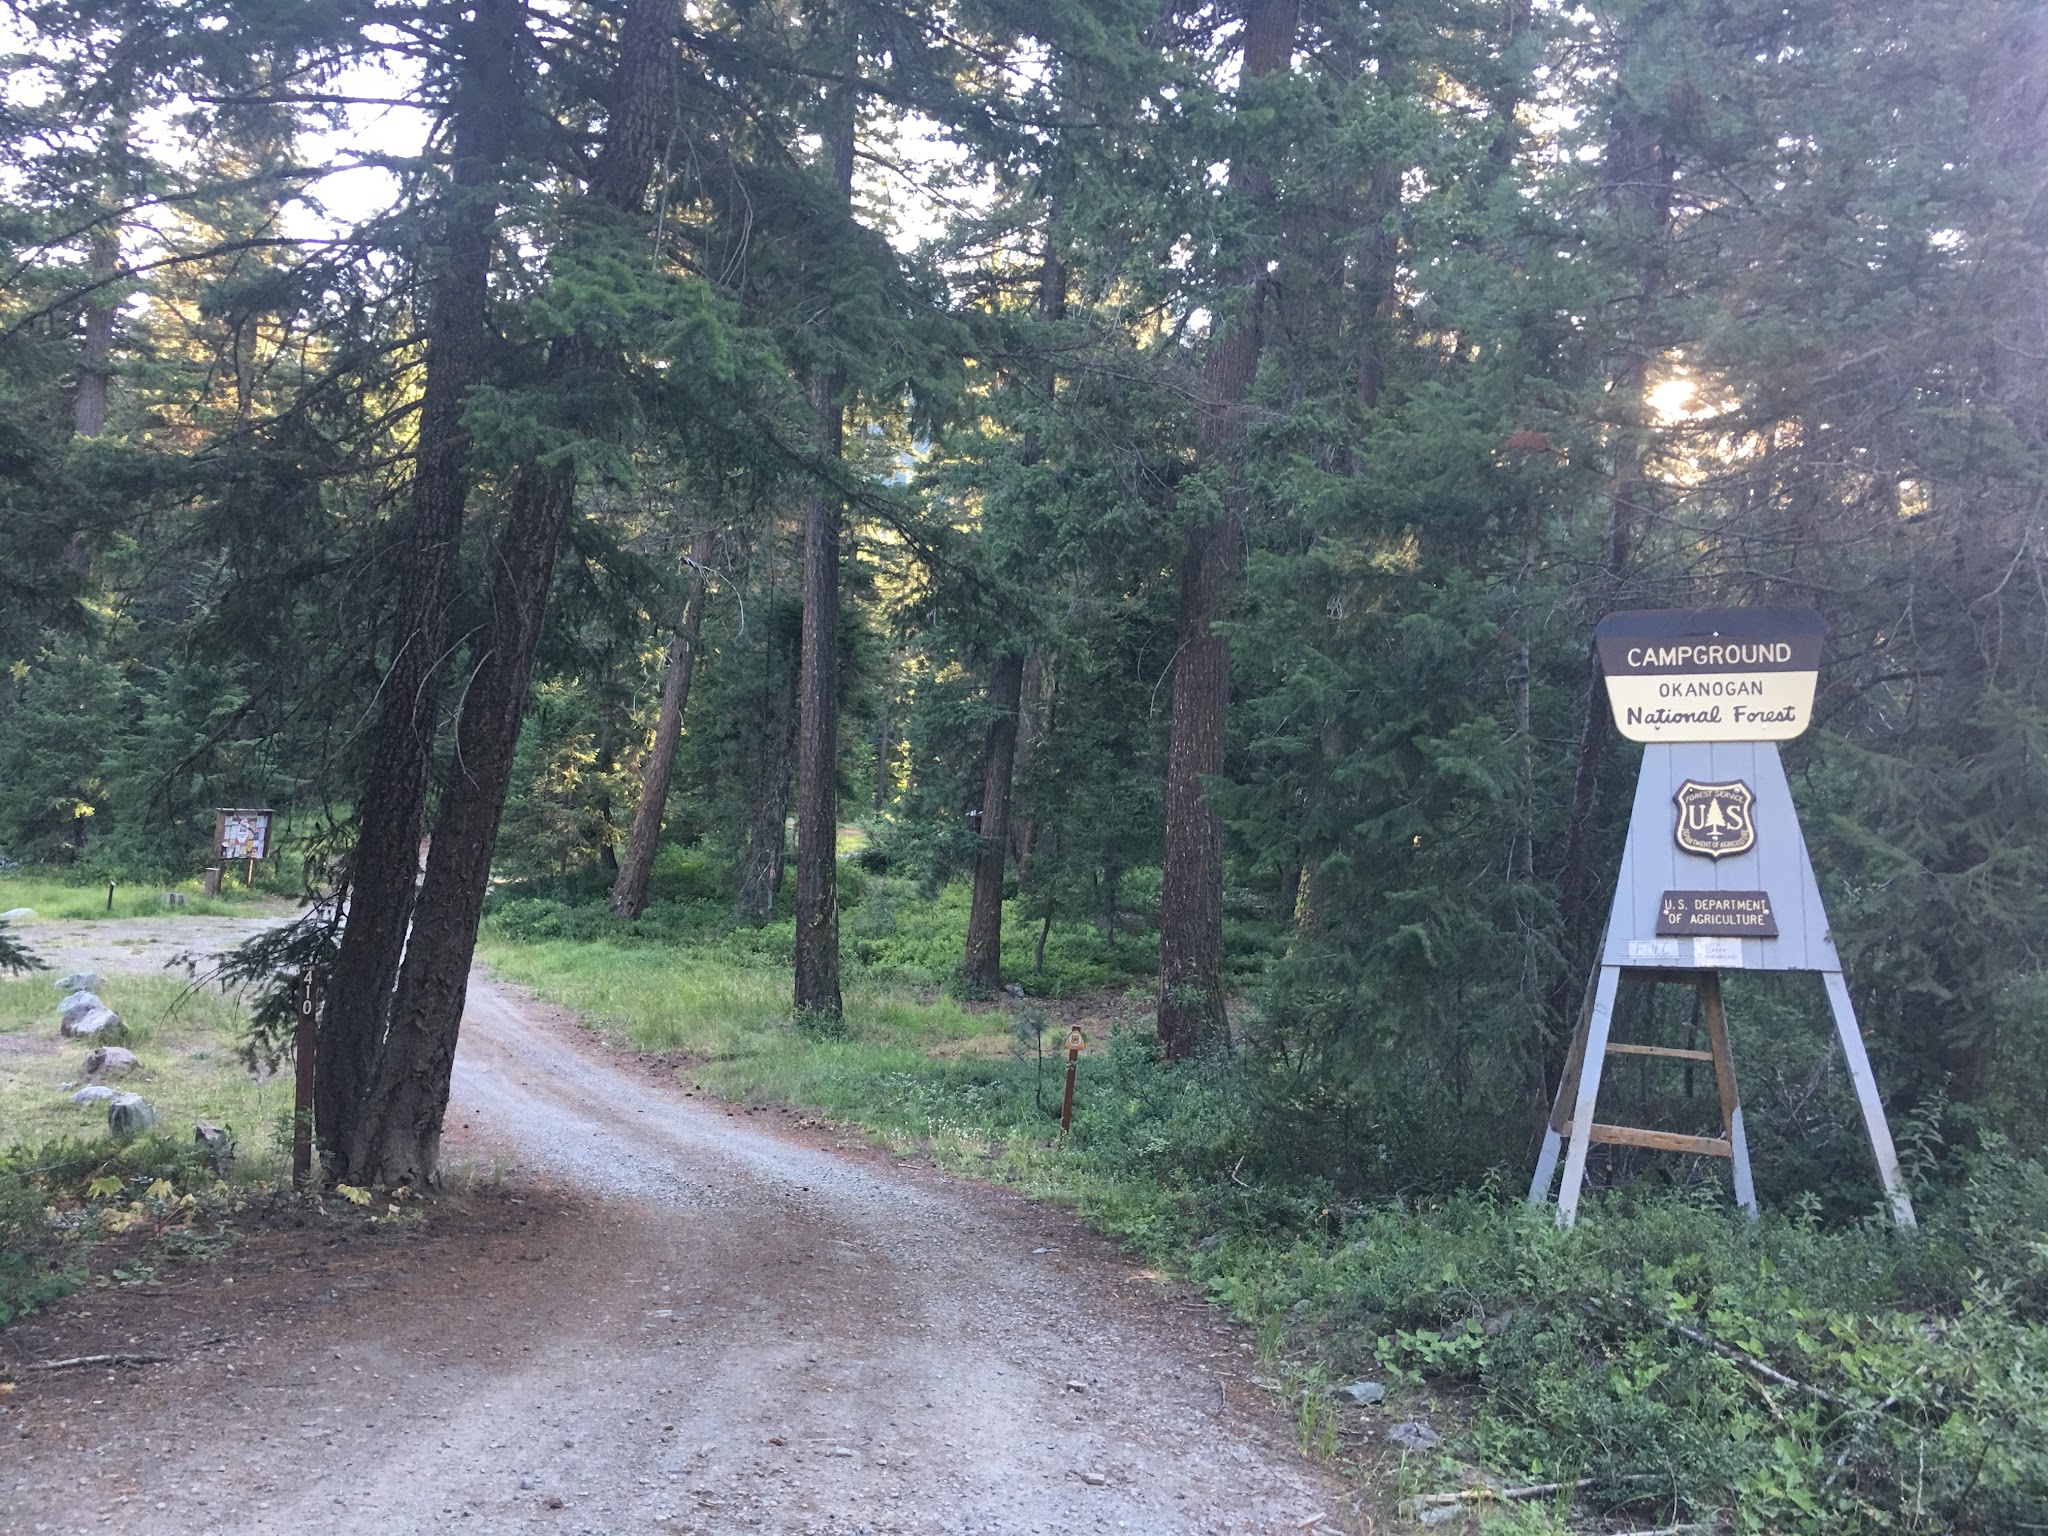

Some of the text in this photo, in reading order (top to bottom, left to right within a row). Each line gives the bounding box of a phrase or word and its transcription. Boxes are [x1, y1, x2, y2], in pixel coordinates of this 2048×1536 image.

[1627, 643, 1791, 667] CAMPGROUND
[1659, 681, 1763, 697] OKANOGAN
[1627, 705, 1796, 725] National Forest
[1685, 790, 1744, 803] FOREST SERVICE
[1664, 899, 1766, 911] U.S. DEPARTMENT
[1668, 913, 1765, 925] OF AGRICULTURE
[302, 970, 313, 1015] 410
